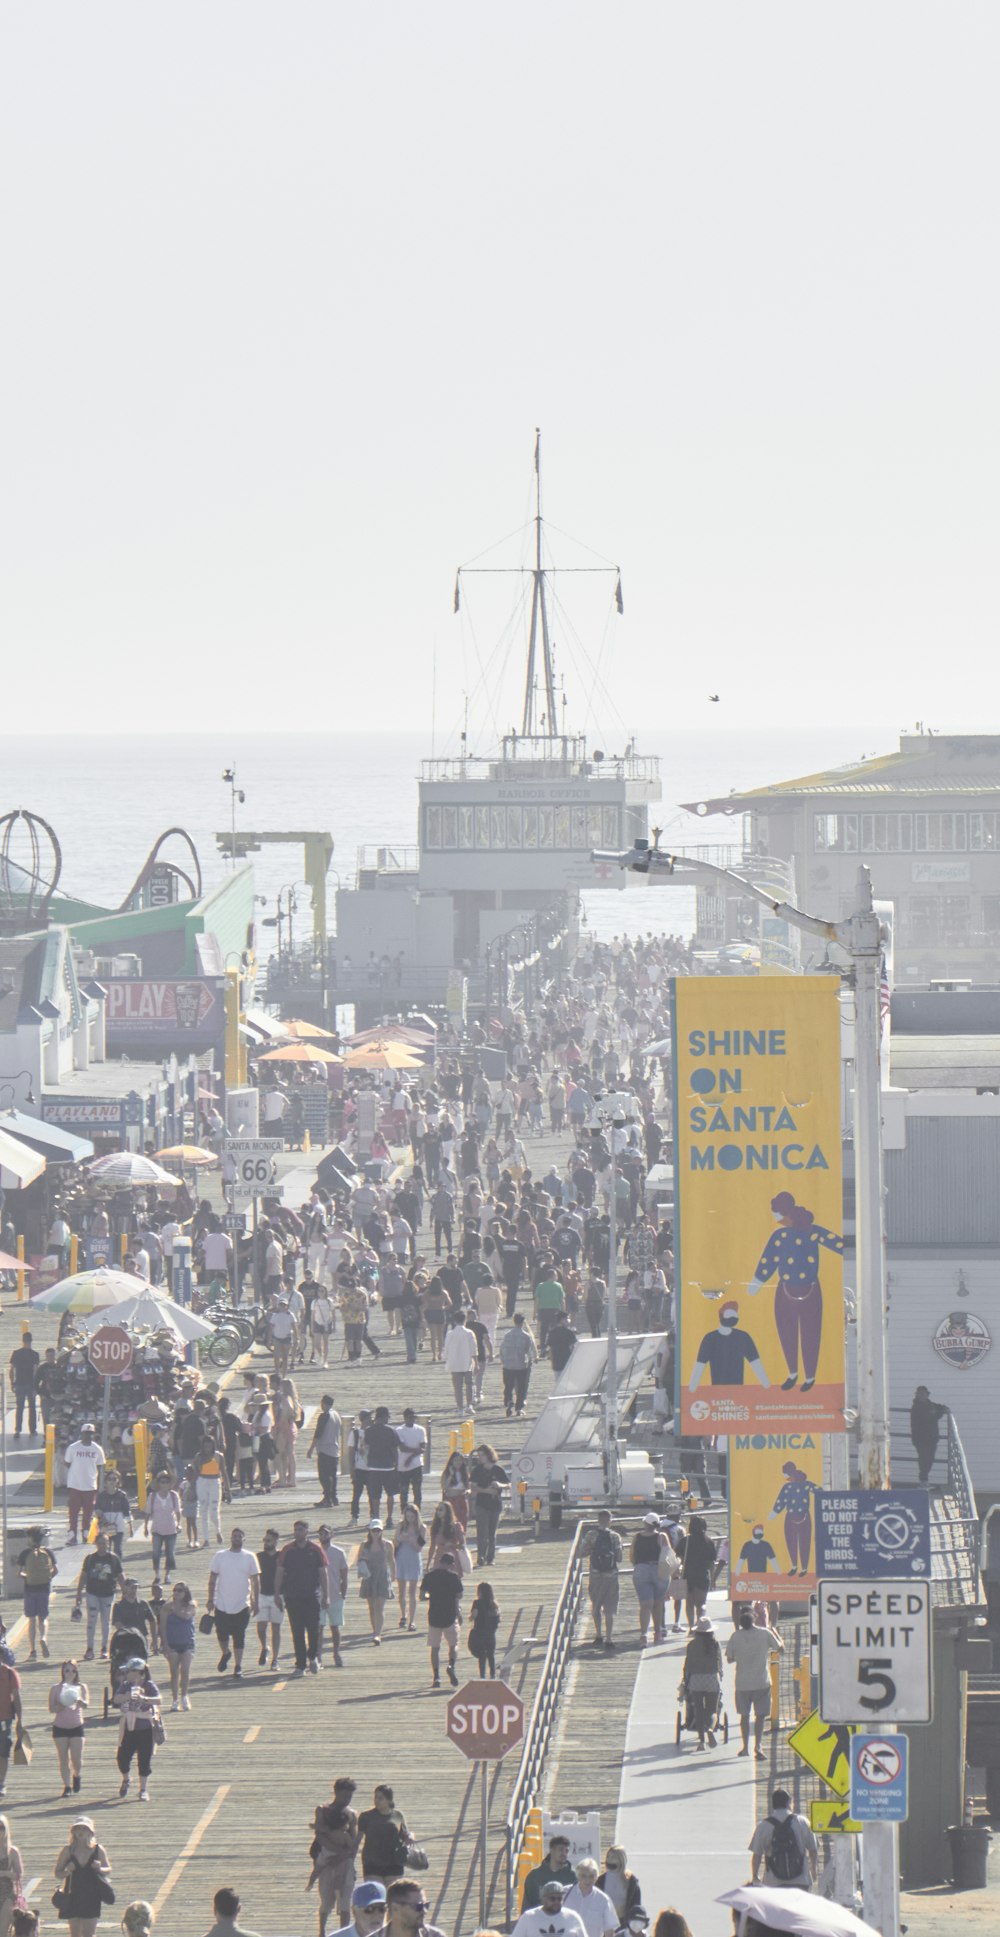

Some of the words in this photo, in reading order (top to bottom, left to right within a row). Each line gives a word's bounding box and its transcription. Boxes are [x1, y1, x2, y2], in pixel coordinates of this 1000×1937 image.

[498, 789, 545, 798] HARBOR
[550, 789, 591, 798] OFFICE
[109, 984, 166, 1017] PLAY
[688, 1030, 786, 1056] SHINE
[690, 1068, 742, 1094] ON
[46, 1106, 118, 1117] PLAYLAND
[690, 1106, 798, 1133] SANTA
[228, 1142, 250, 1151] SANTA
[252, 1142, 281, 1151] MONICA
[690, 1144, 830, 1171] MONICA
[242, 1159, 267, 1181] 66
[253, 1188, 265, 1196] the
[936, 1338, 963, 1348] BUBBA
[965, 1338, 990, 1349] GUMP
[92, 1341, 130, 1360] STOP
[711, 1411, 749, 1421] SHINES
[736, 1434, 816, 1450] MONICA
[76, 1450, 96, 1458] NIKE
[822, 1500, 858, 1510] PLEASE
[822, 1512, 835, 1522] DO
[839, 1512, 858, 1522] NOT
[828, 1525, 853, 1535] FEED
[831, 1537, 850, 1547] THE
[824, 1549, 857, 1560] BIRDS.
[826, 1594, 923, 1615] SPEED
[836, 1627, 914, 1648] LIMIT
[857, 1658, 896, 1713] 5
[451, 1704, 520, 1734] STOP
